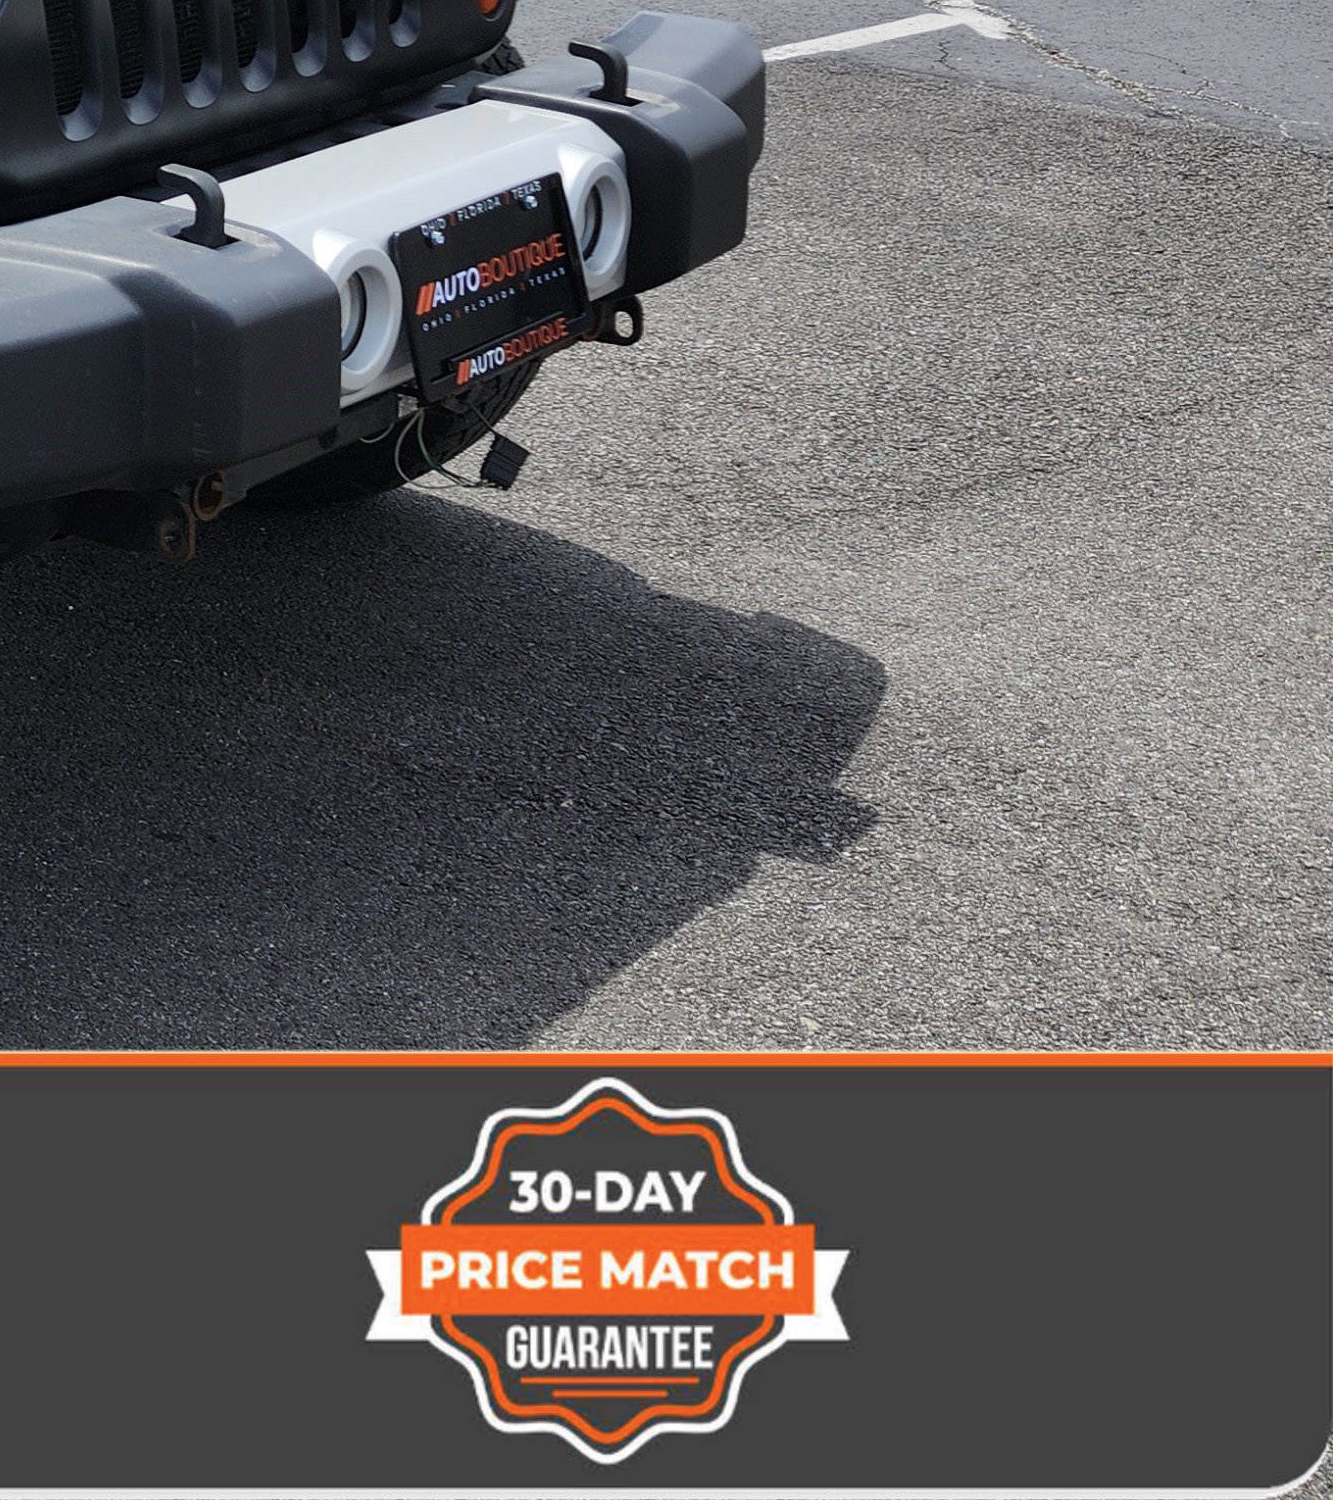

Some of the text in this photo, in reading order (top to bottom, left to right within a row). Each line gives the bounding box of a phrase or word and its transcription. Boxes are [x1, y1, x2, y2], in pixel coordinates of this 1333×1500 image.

[457, 196, 502, 222] FLORIDA
[511, 180, 542, 200] TEXAS
[422, 266, 566, 332] OHIO FLORIDA TEXAS
